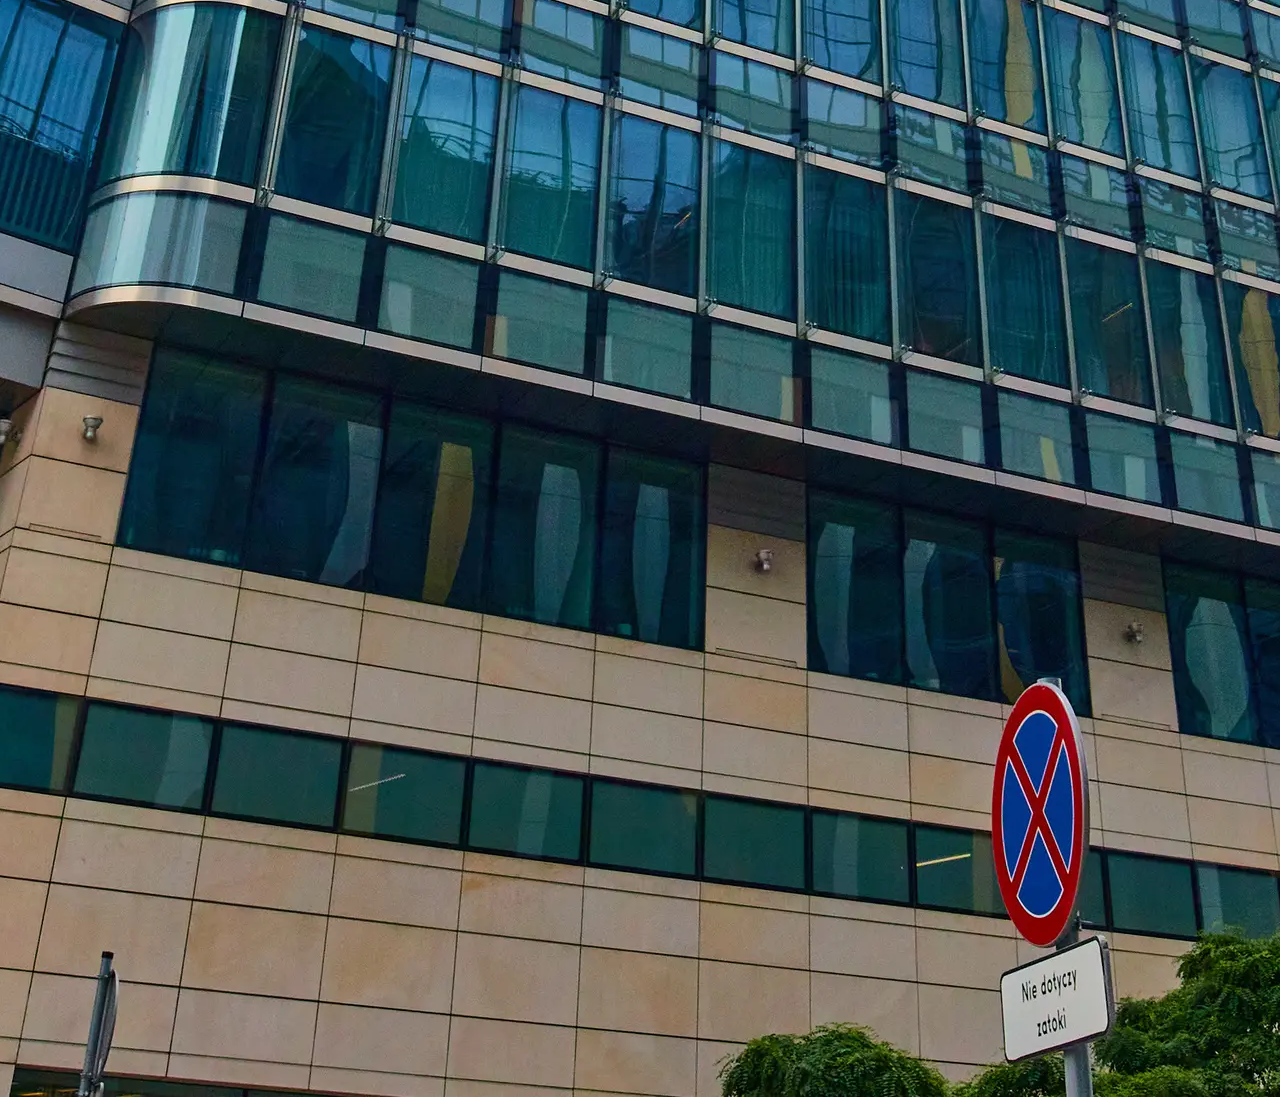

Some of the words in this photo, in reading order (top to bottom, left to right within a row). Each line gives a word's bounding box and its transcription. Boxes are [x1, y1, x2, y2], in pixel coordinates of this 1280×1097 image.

[1021, 981, 1038, 1003] Nie
[1040, 969, 1077, 996] dotyczy
[1036, 1007, 1067, 1037] zatoki
